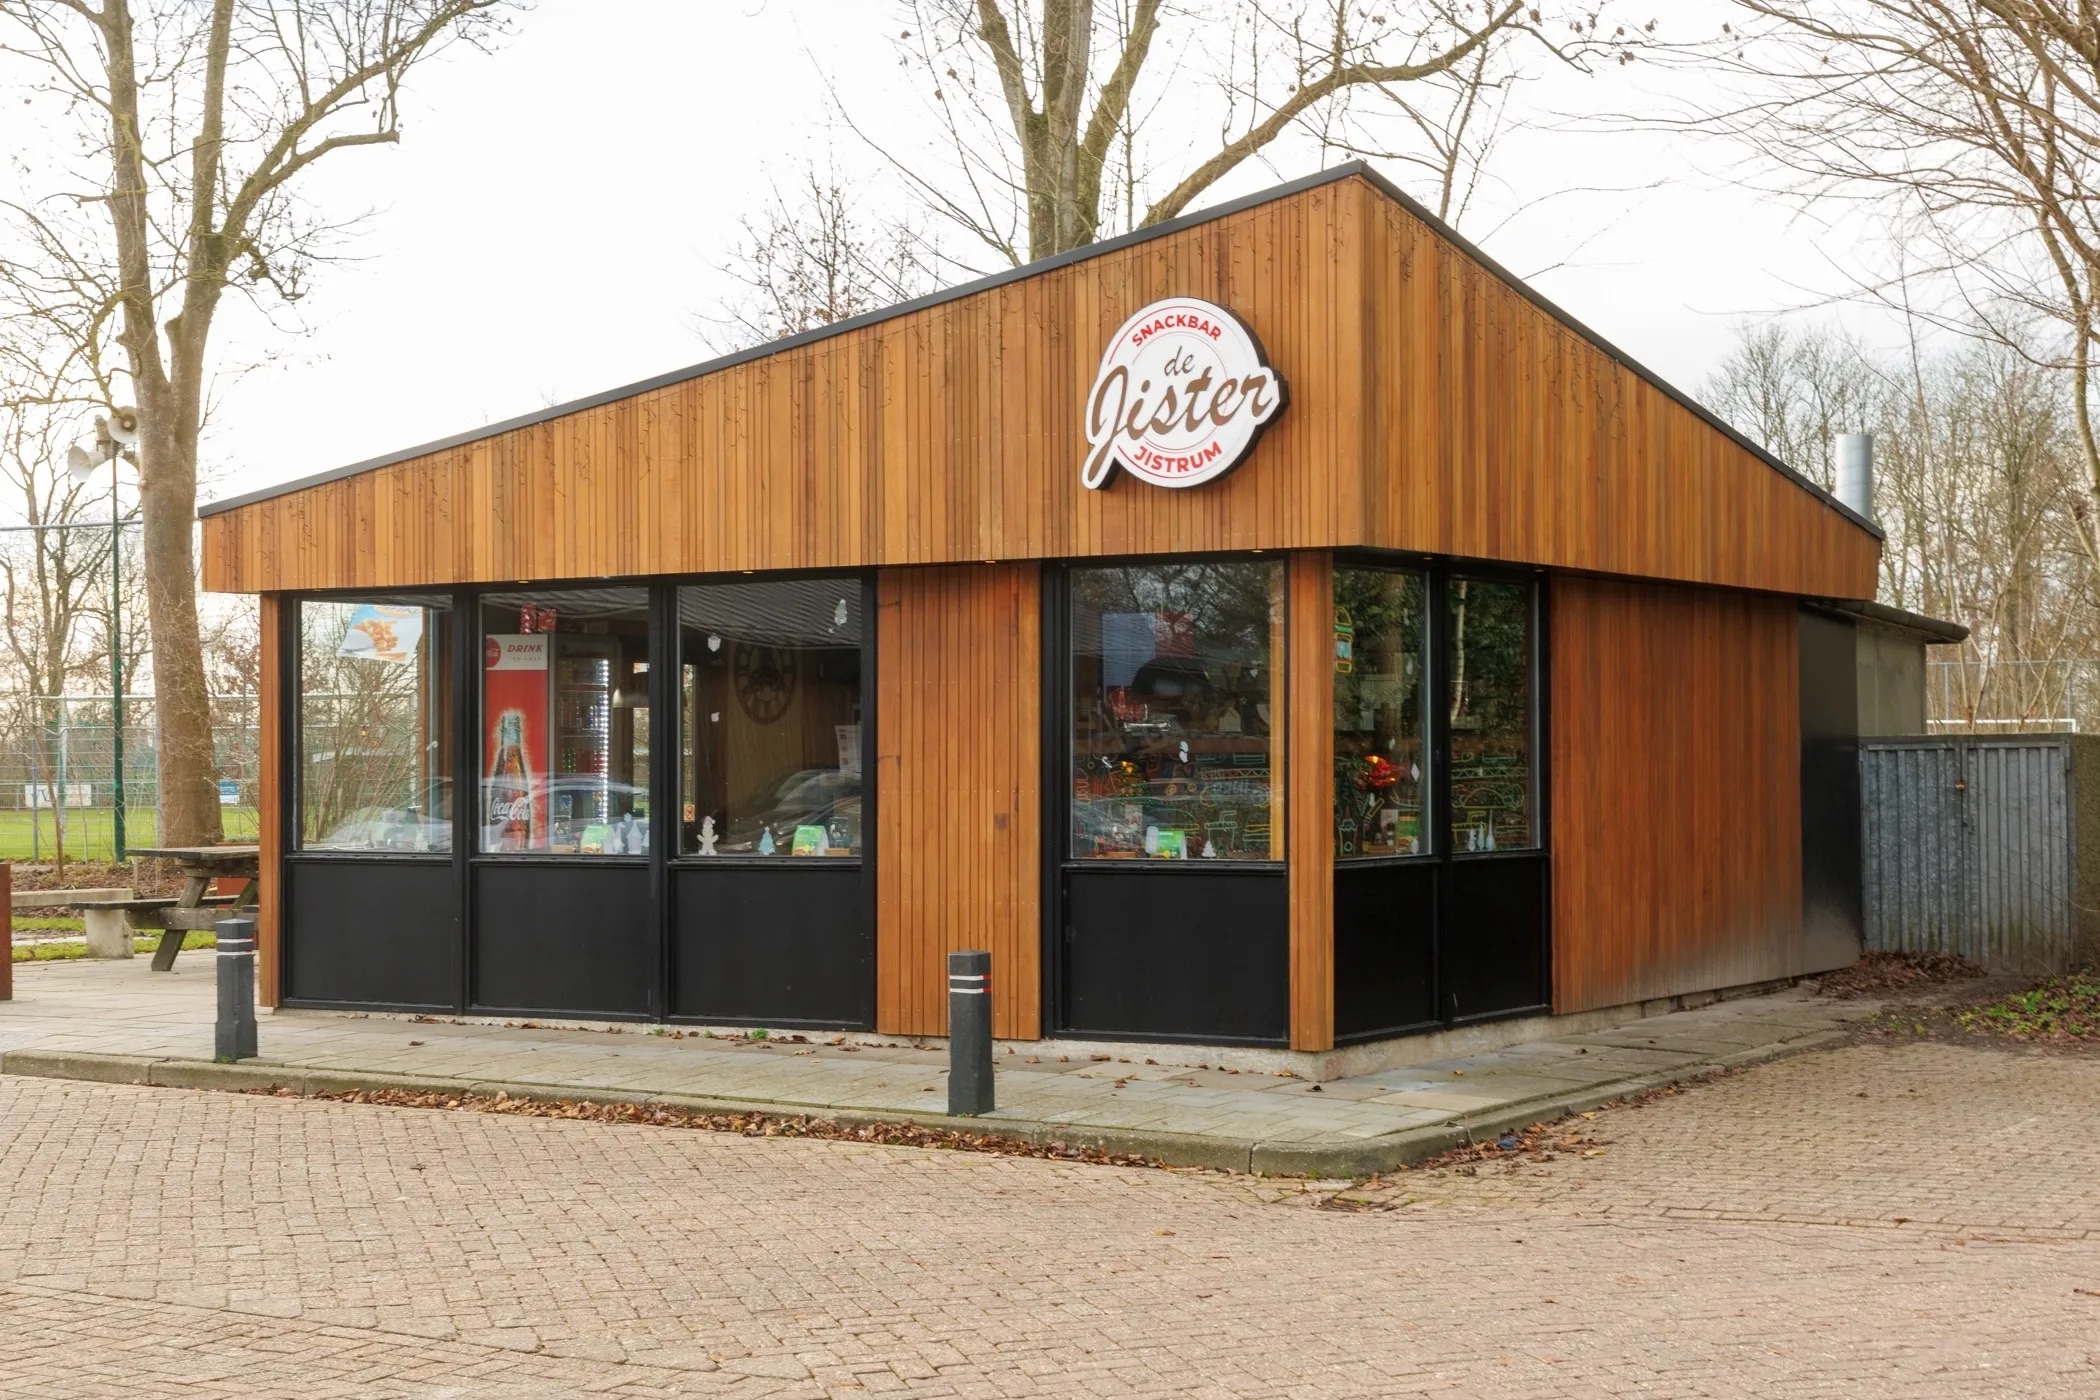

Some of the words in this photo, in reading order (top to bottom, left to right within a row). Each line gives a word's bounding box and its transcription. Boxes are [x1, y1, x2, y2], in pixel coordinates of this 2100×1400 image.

[1132, 314, 1222, 347] SNACKBAR
[1163, 345, 1196, 377] de
[1087, 364, 1273, 483] Jister
[1133, 441, 1223, 473] JISTRUM
[507, 644, 544, 653] DRINK
